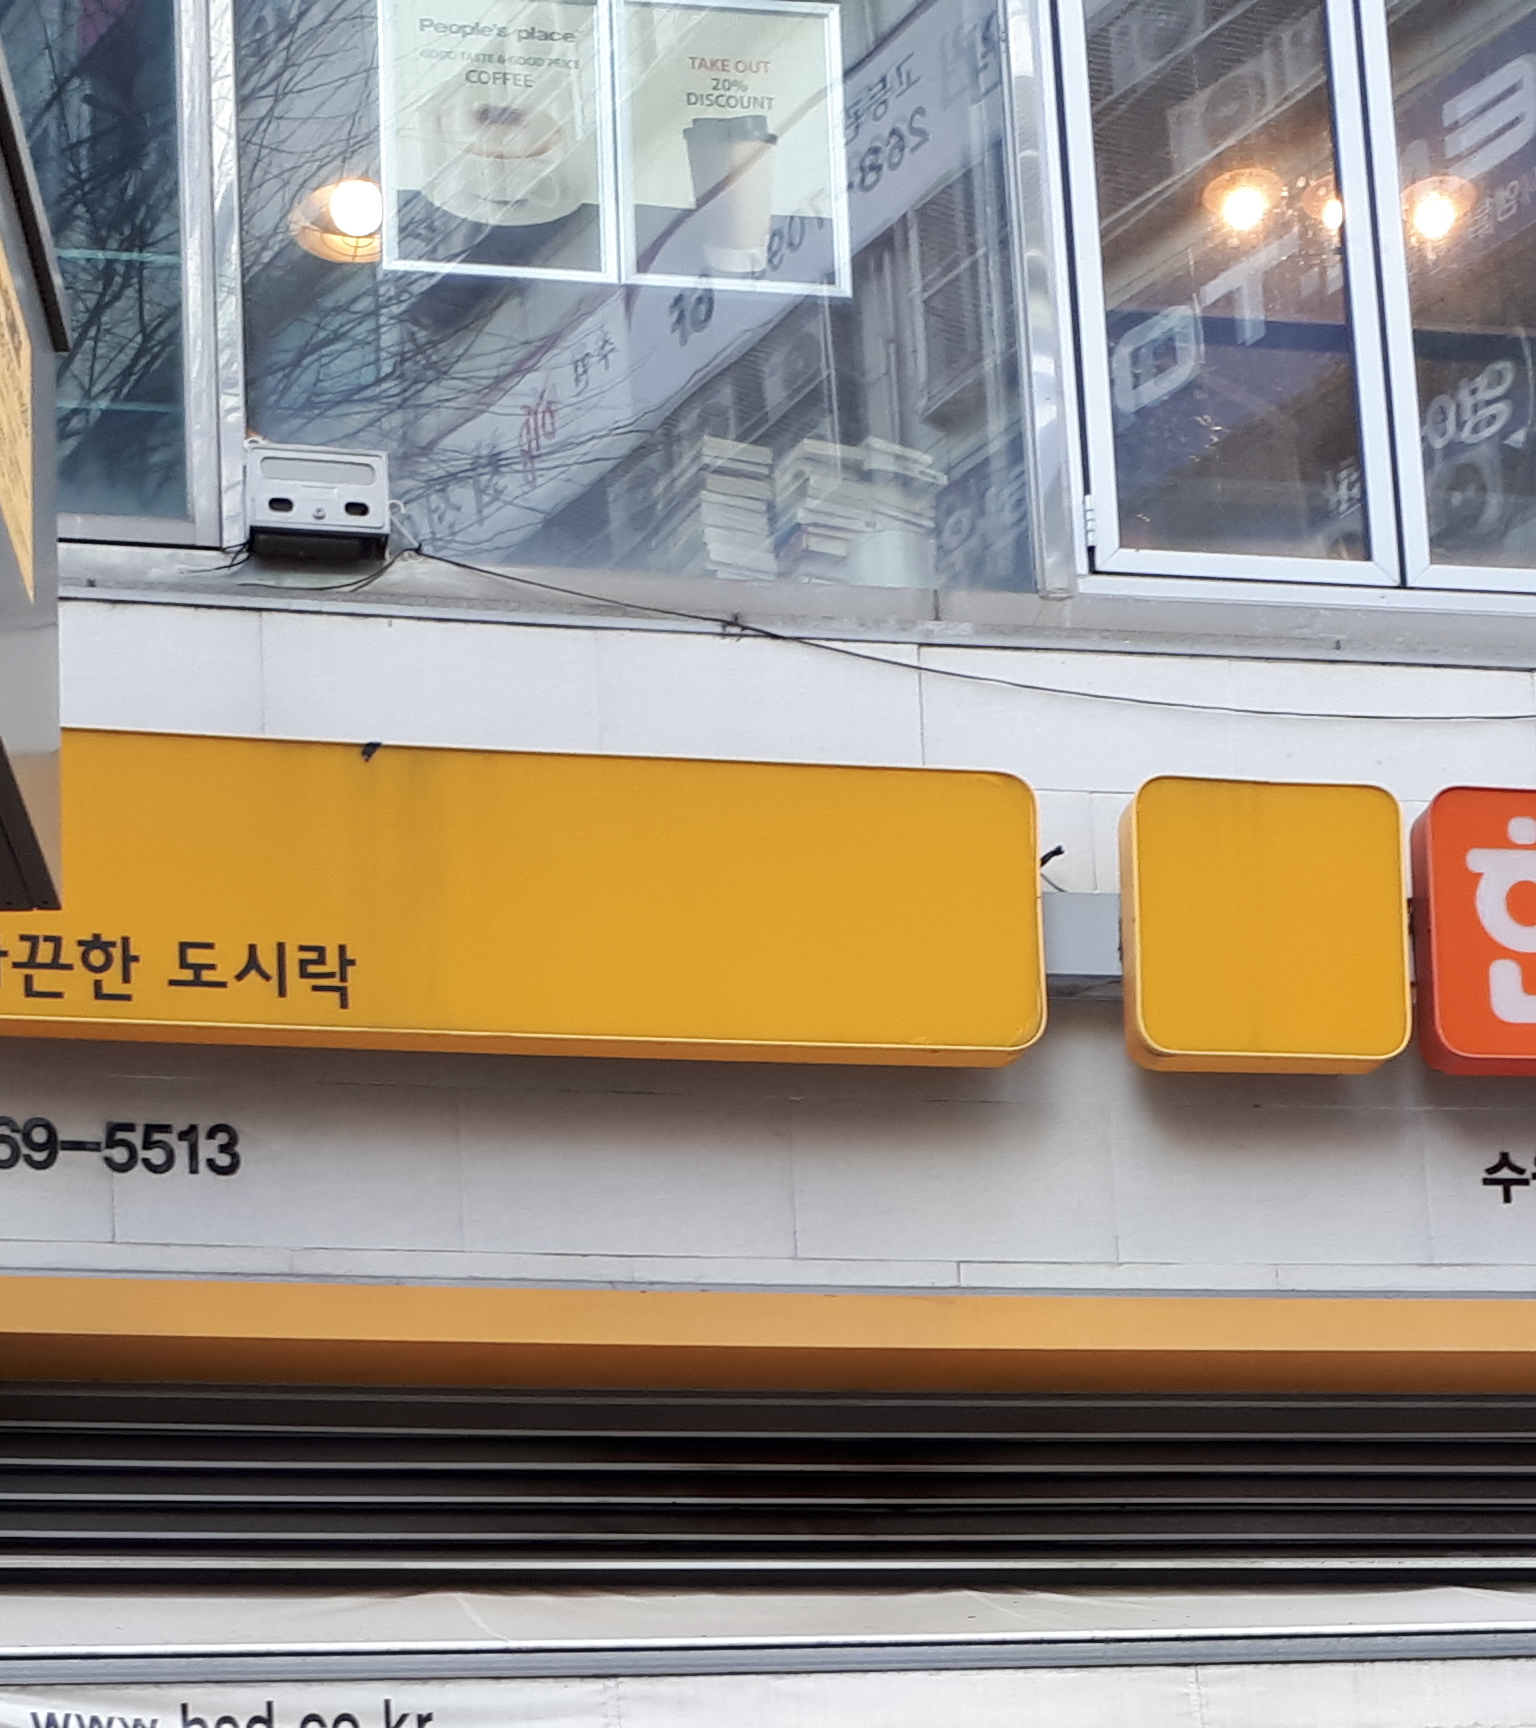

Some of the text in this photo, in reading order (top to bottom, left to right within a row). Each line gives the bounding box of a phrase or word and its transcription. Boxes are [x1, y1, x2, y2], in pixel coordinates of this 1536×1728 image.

[419, 18, 576, 43] People's place
[689, 56, 771, 74] TAKE OUT
[465, 69, 536, 88] COFFEE
[710, 77, 749, 92] 20%
[686, 92, 774, 111] DISCOUNT
[167, 940, 357, 1010] 도시락
